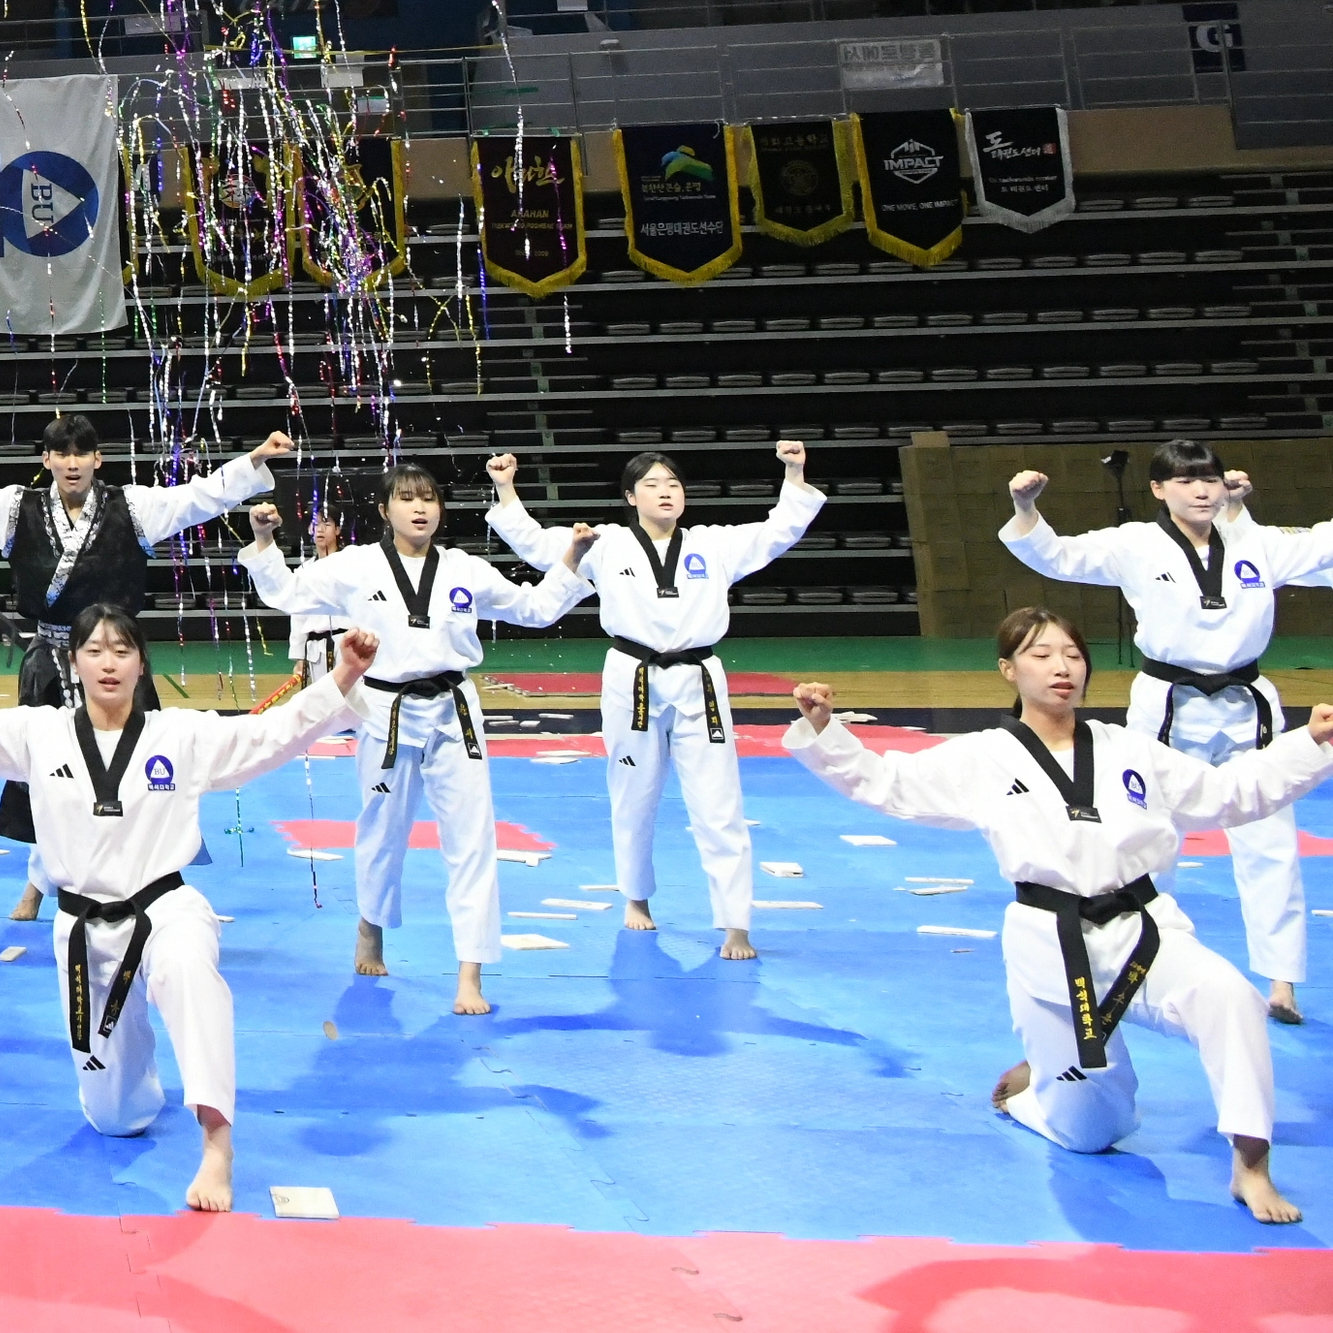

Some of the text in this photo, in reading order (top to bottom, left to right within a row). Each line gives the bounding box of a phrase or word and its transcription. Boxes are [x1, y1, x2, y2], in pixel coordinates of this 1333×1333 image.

[1195, 20, 1236, 56] G
[883, 155, 945, 170] IMPACT
[30, 182, 55, 224] BU
